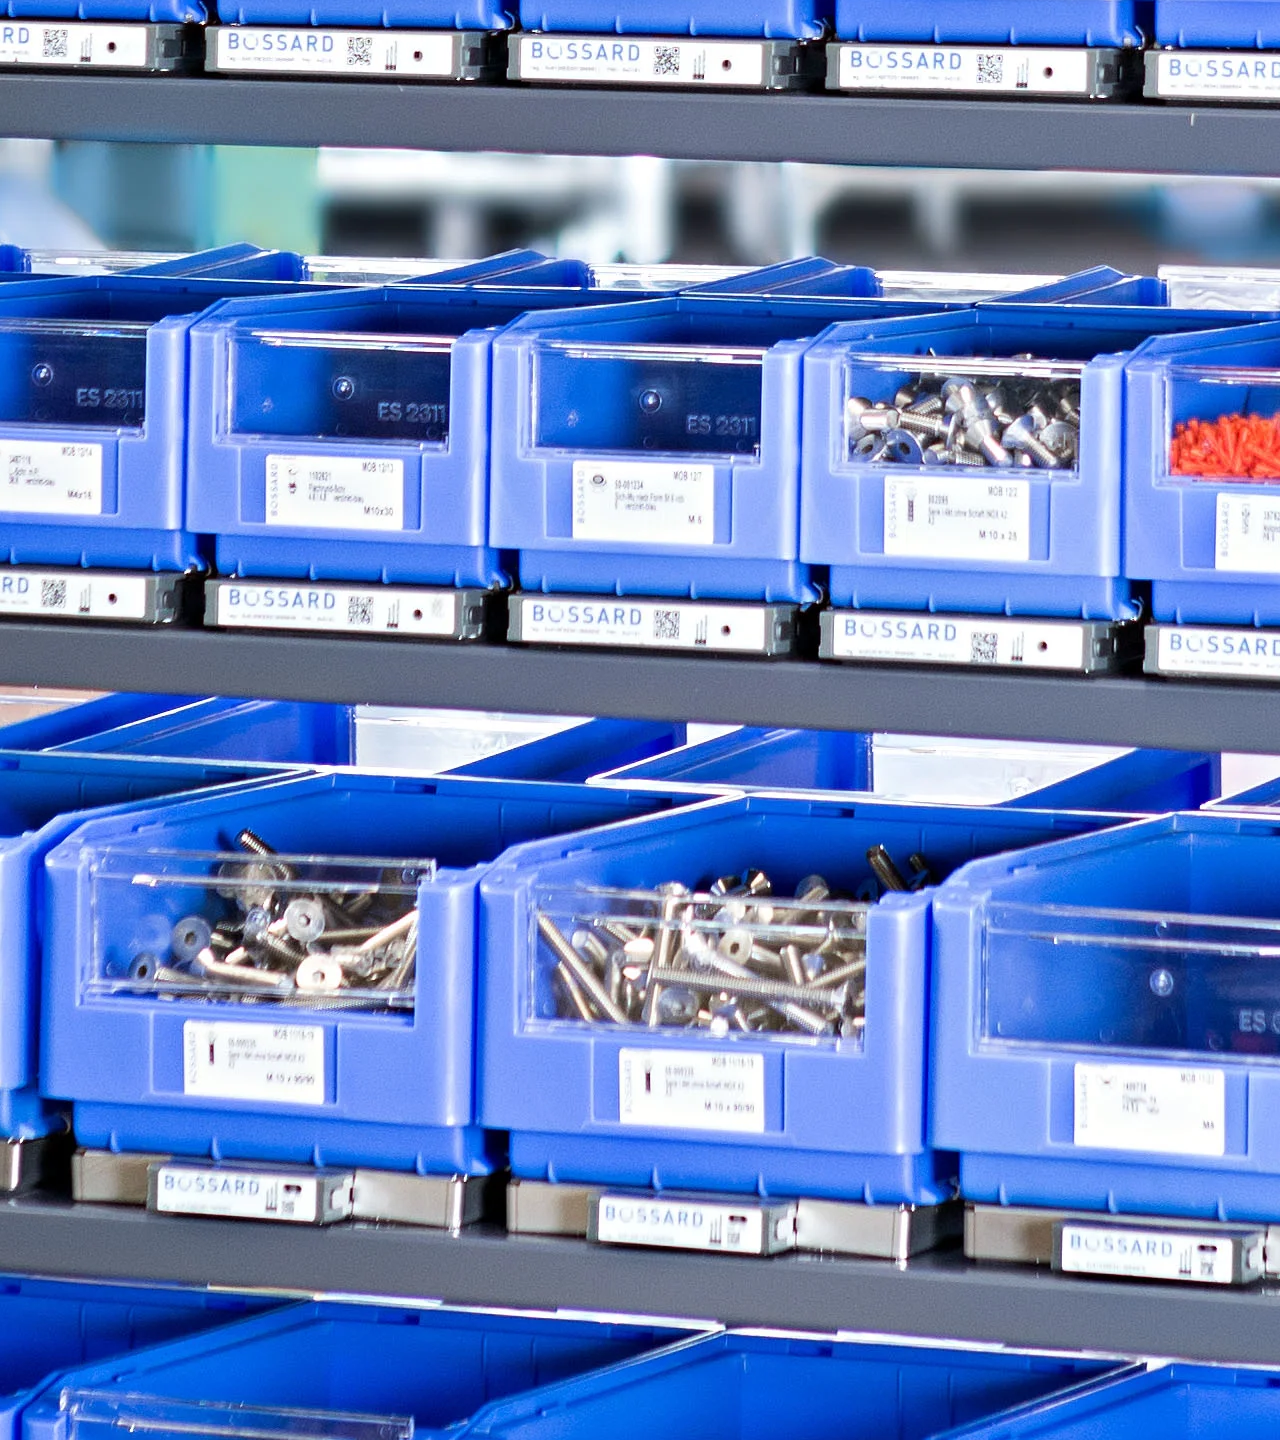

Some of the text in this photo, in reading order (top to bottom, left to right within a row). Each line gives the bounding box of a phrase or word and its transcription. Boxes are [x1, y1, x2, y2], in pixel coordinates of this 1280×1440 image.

[228, 31, 335, 52] BOSSARD
[532, 40, 641, 61] BOSSARD
[851, 51, 961, 70] BOSSARD
[230, 588, 337, 609] BOSSARD
[533, 603, 643, 625] BOSSARD
[845, 618, 958, 641] BOSSARD
[165, 1174, 261, 1195] BOSSARD
[606, 1203, 705, 1227] BOSSARD
[1071, 1233, 1174, 1256] BOSSARD
